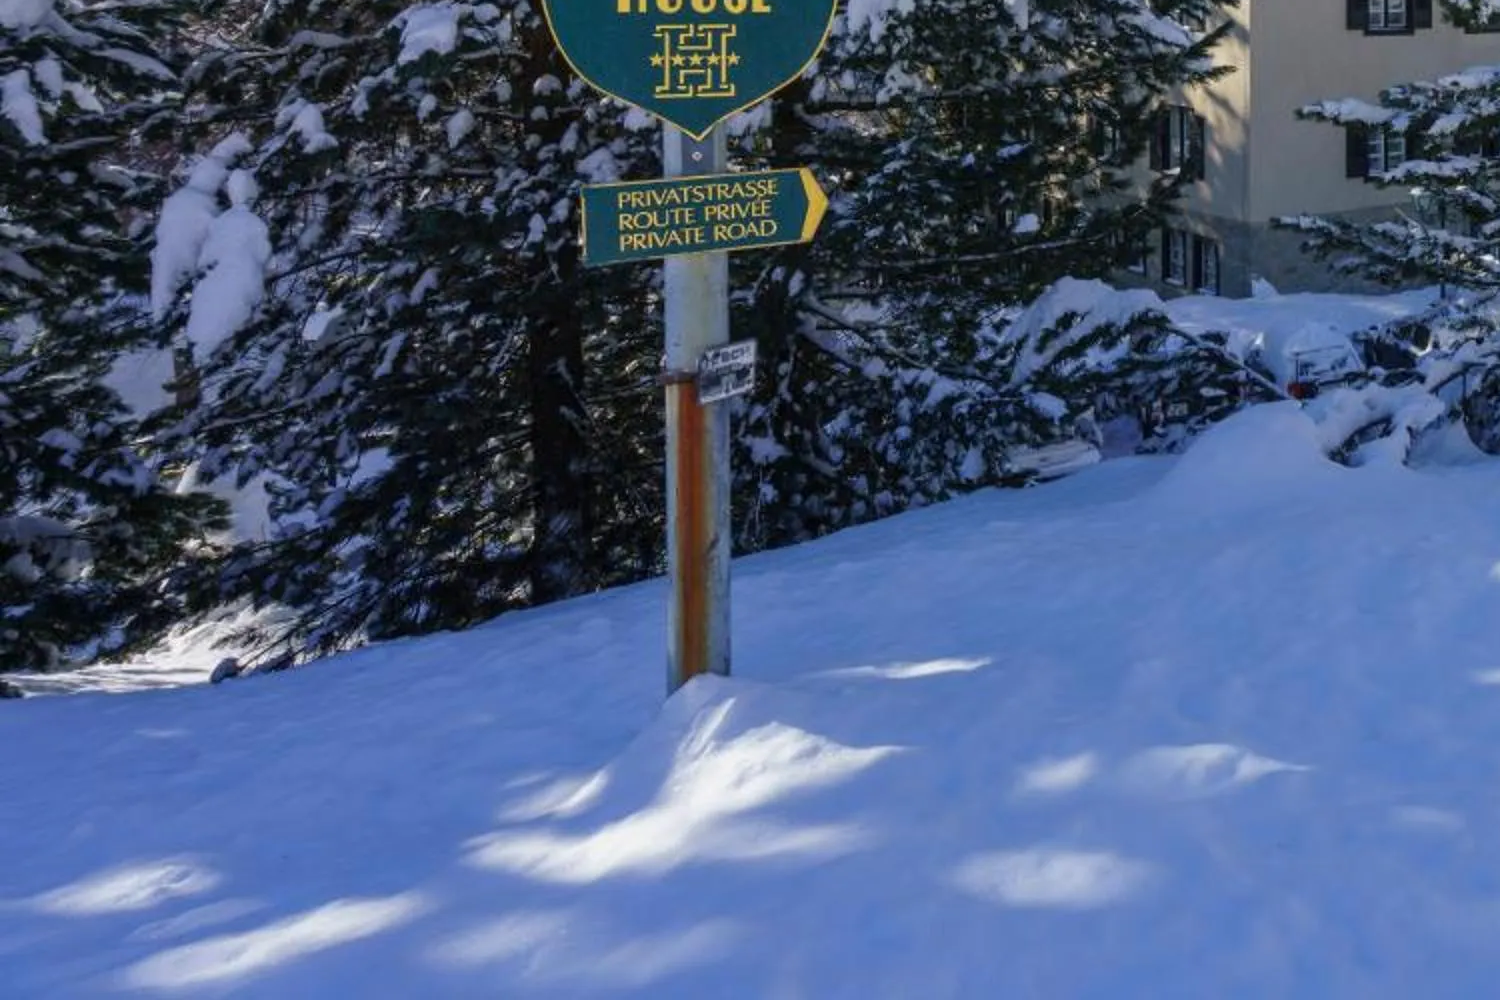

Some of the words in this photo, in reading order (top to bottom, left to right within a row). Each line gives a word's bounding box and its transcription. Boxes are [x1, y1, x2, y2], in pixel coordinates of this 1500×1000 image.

[618, 178, 778, 209] PRIVATSTRASSE
[619, 207, 696, 231] ROUTE
[620, 226, 705, 252] PRIVATE
[713, 219, 778, 242] ROAD
